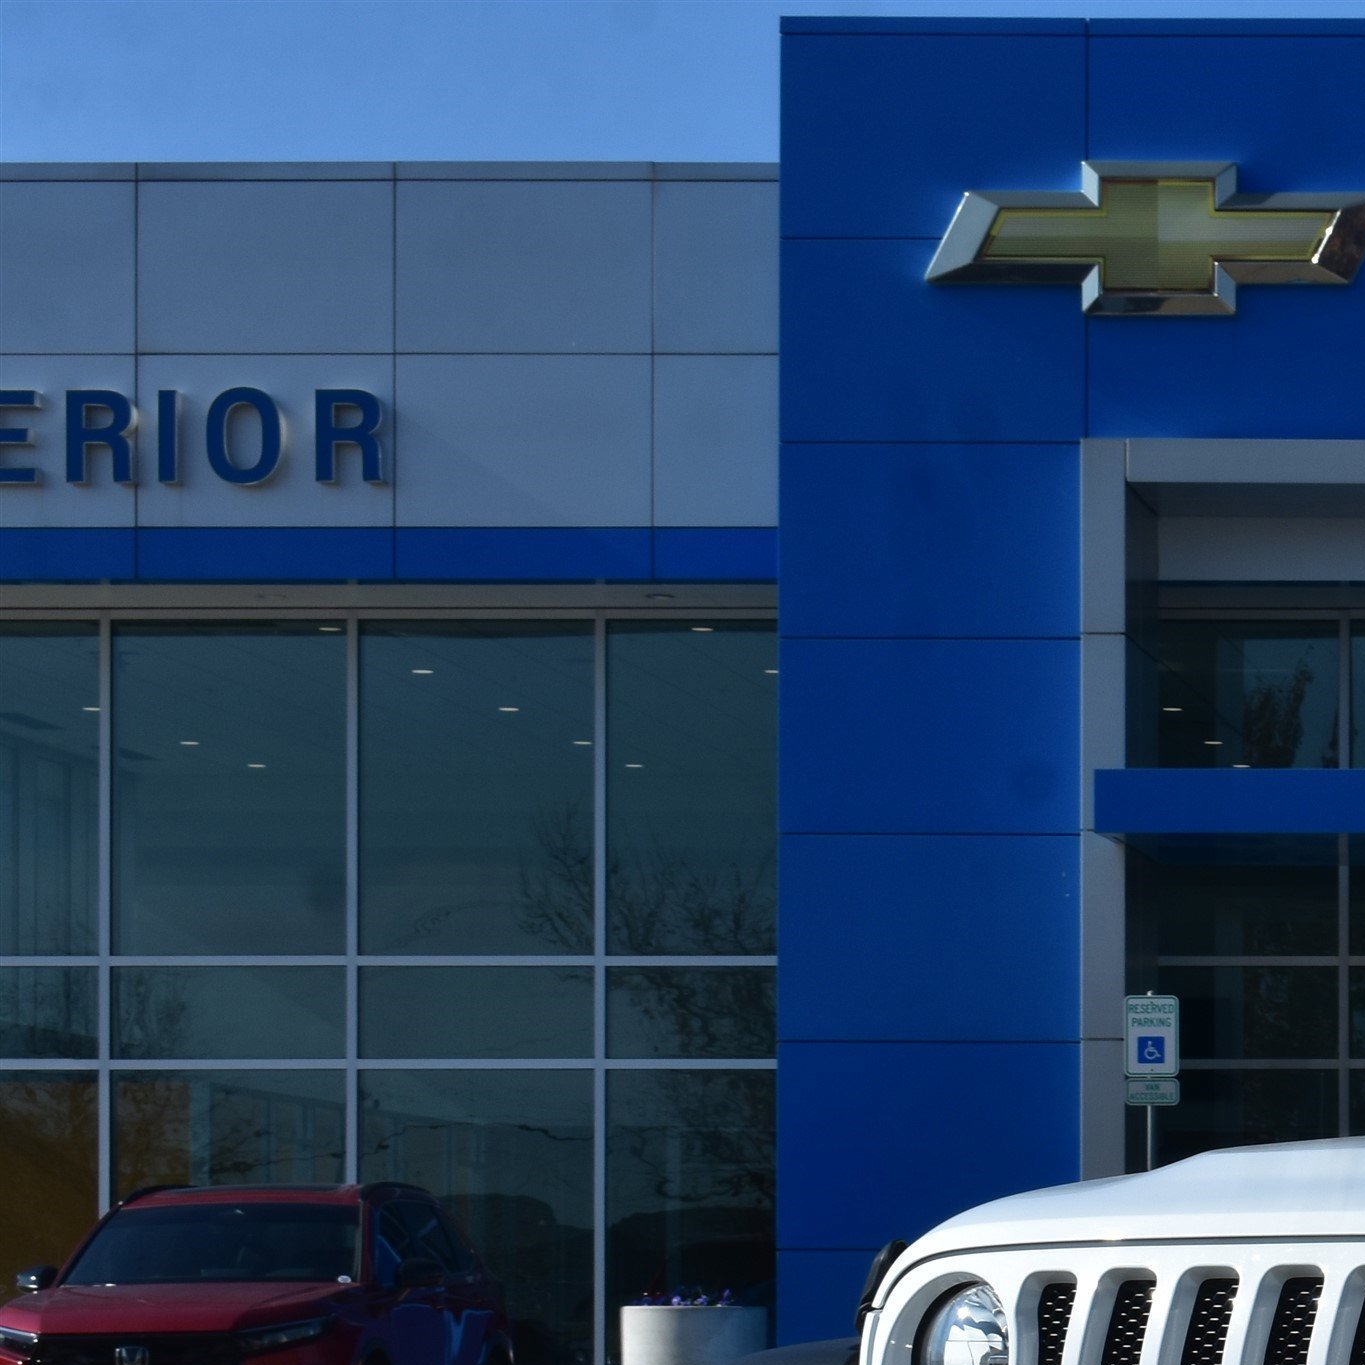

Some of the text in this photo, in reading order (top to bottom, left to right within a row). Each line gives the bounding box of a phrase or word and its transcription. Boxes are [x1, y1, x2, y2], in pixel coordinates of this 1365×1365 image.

[1128, 1003, 1175, 1014] RESERVED
[1131, 1018, 1172, 1027] PARKING
[1129, 1092, 1175, 1101] ACCESSIBLE
